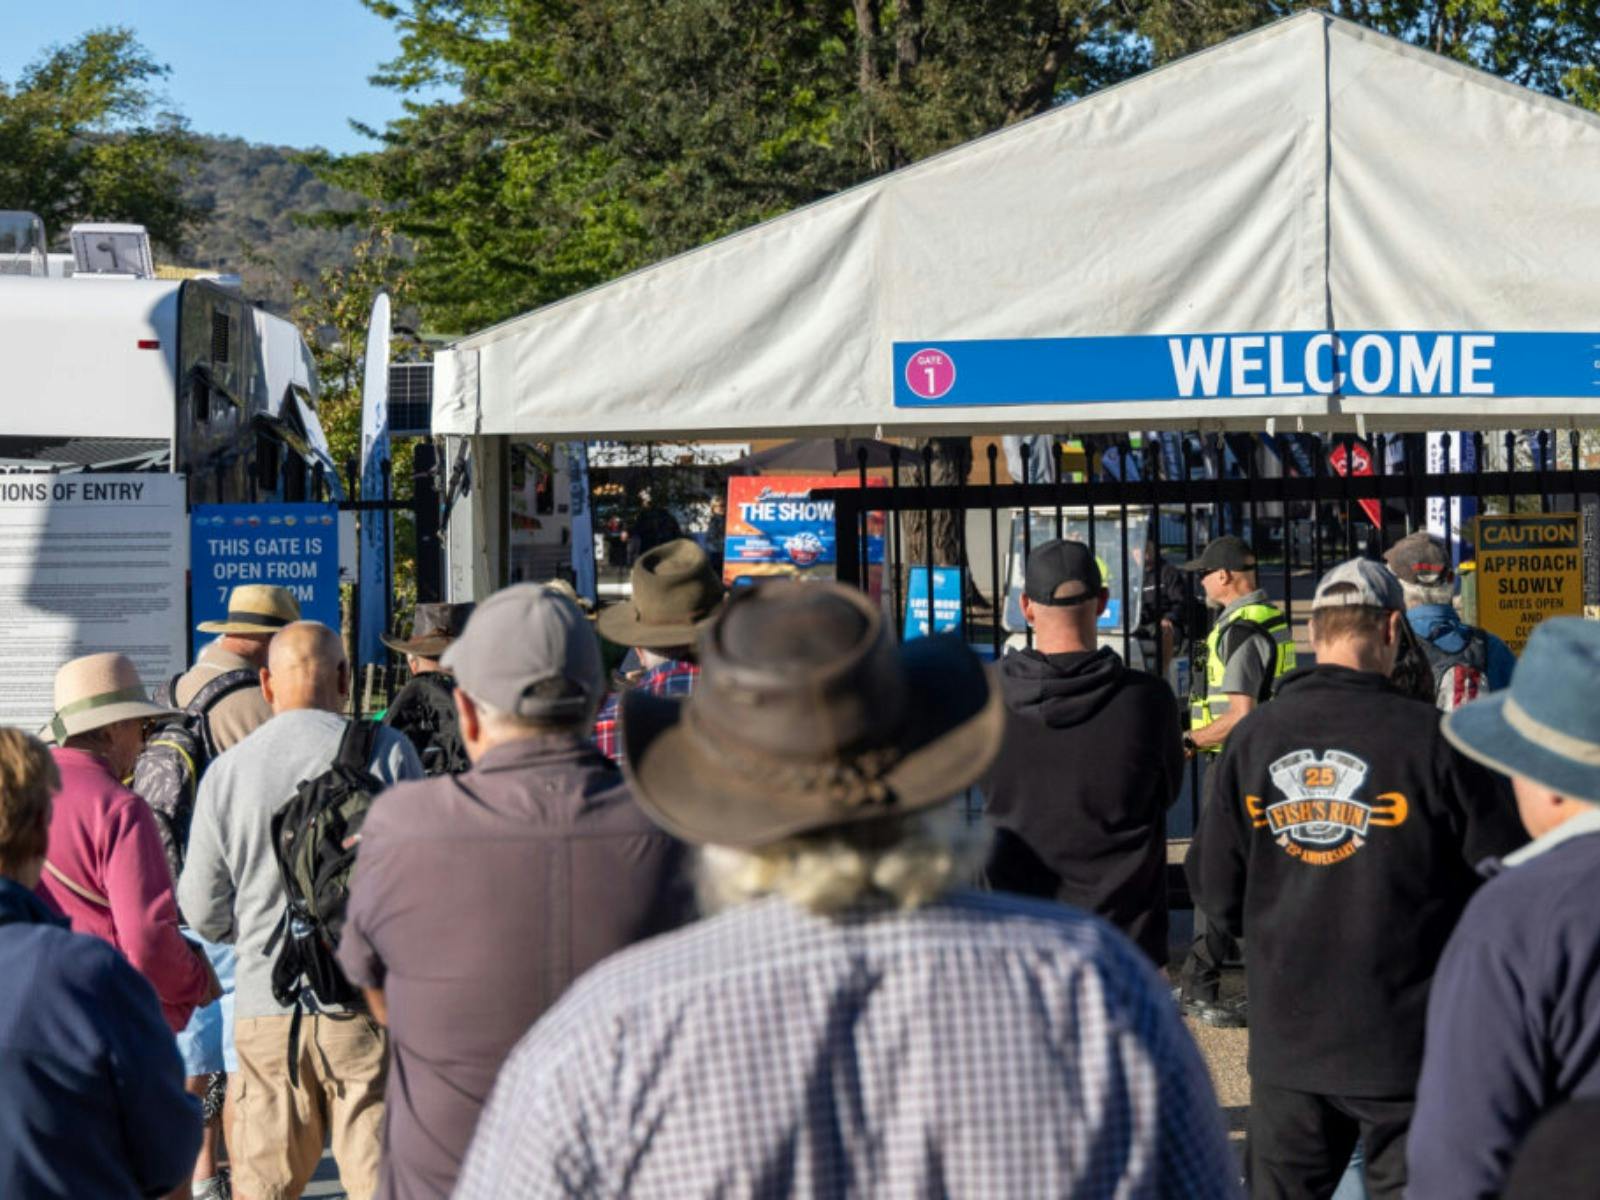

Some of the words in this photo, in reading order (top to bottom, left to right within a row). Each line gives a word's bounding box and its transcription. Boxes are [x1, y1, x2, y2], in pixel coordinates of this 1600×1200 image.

[917, 355, 943, 366] GATE
[1168, 333, 1496, 397] WELCOME
[924, 368, 935, 394] 1
[0, 483, 47, 501] IONS
[52, 483, 77, 501] OF
[83, 483, 144, 501] ENTRY
[738, 502, 777, 521] THE
[779, 502, 835, 521] SHOW
[1484, 525, 1575, 543] CAUTION
[208, 539, 250, 556] THIS
[254, 538, 300, 556] GATE
[305, 537, 323, 555] IS
[213, 562, 261, 580] OPEN
[267, 562, 317, 578] FROM
[1484, 555, 1577, 573] APPROACH
[1498, 577, 1564, 595] SLOWLY
[1499, 597, 1532, 610] GATES
[1536, 597, 1564, 609] OPEN
[1521, 611, 1543, 623] AND
[1305, 768, 1335, 786] 25
[1271, 801, 1326, 828] FISH'S
[1329, 801, 1366, 828] RUN
